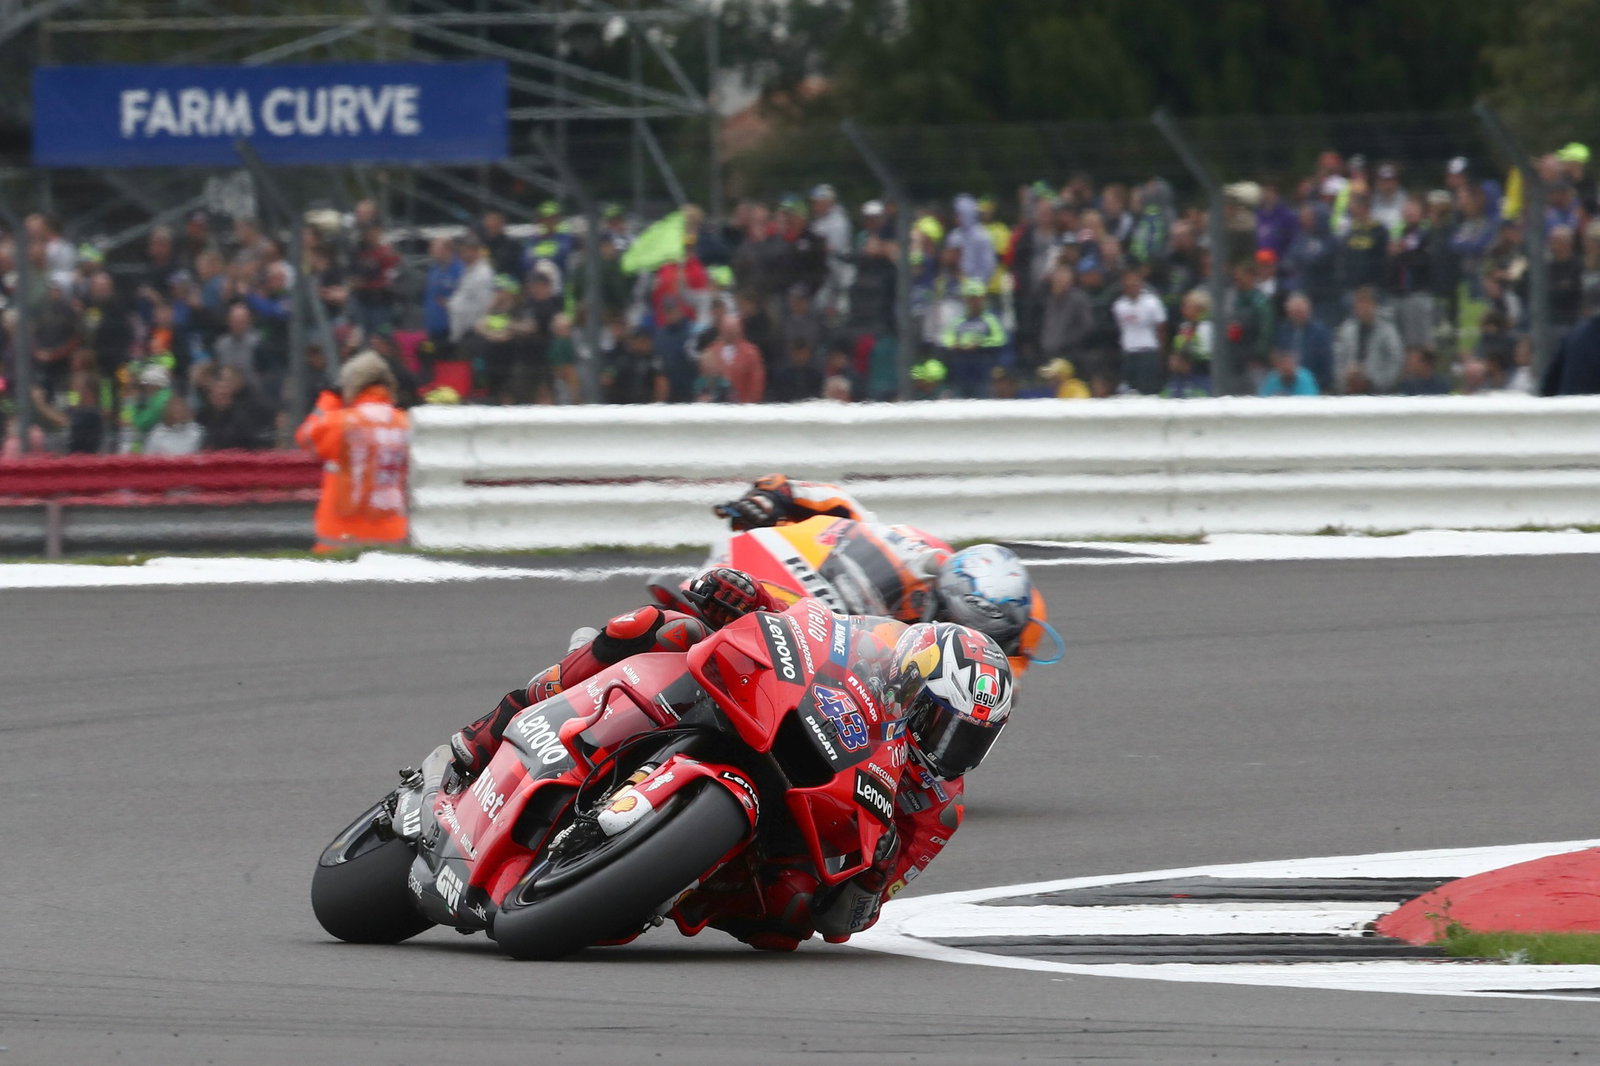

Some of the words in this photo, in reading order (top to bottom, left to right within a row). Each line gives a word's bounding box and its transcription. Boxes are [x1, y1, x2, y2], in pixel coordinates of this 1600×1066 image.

[120, 87, 254, 137] FARM
[261, 84, 421, 136] CURVE
[765, 615, 796, 680] Lenovo
[813, 684, 869, 752] 43
[856, 685, 878, 722] NetApp
[516, 703, 569, 765] Lenovo
[805, 715, 838, 761] DUCATI
[856, 775, 893, 818] Lenovo
[435, 864, 463, 912] GIVI
